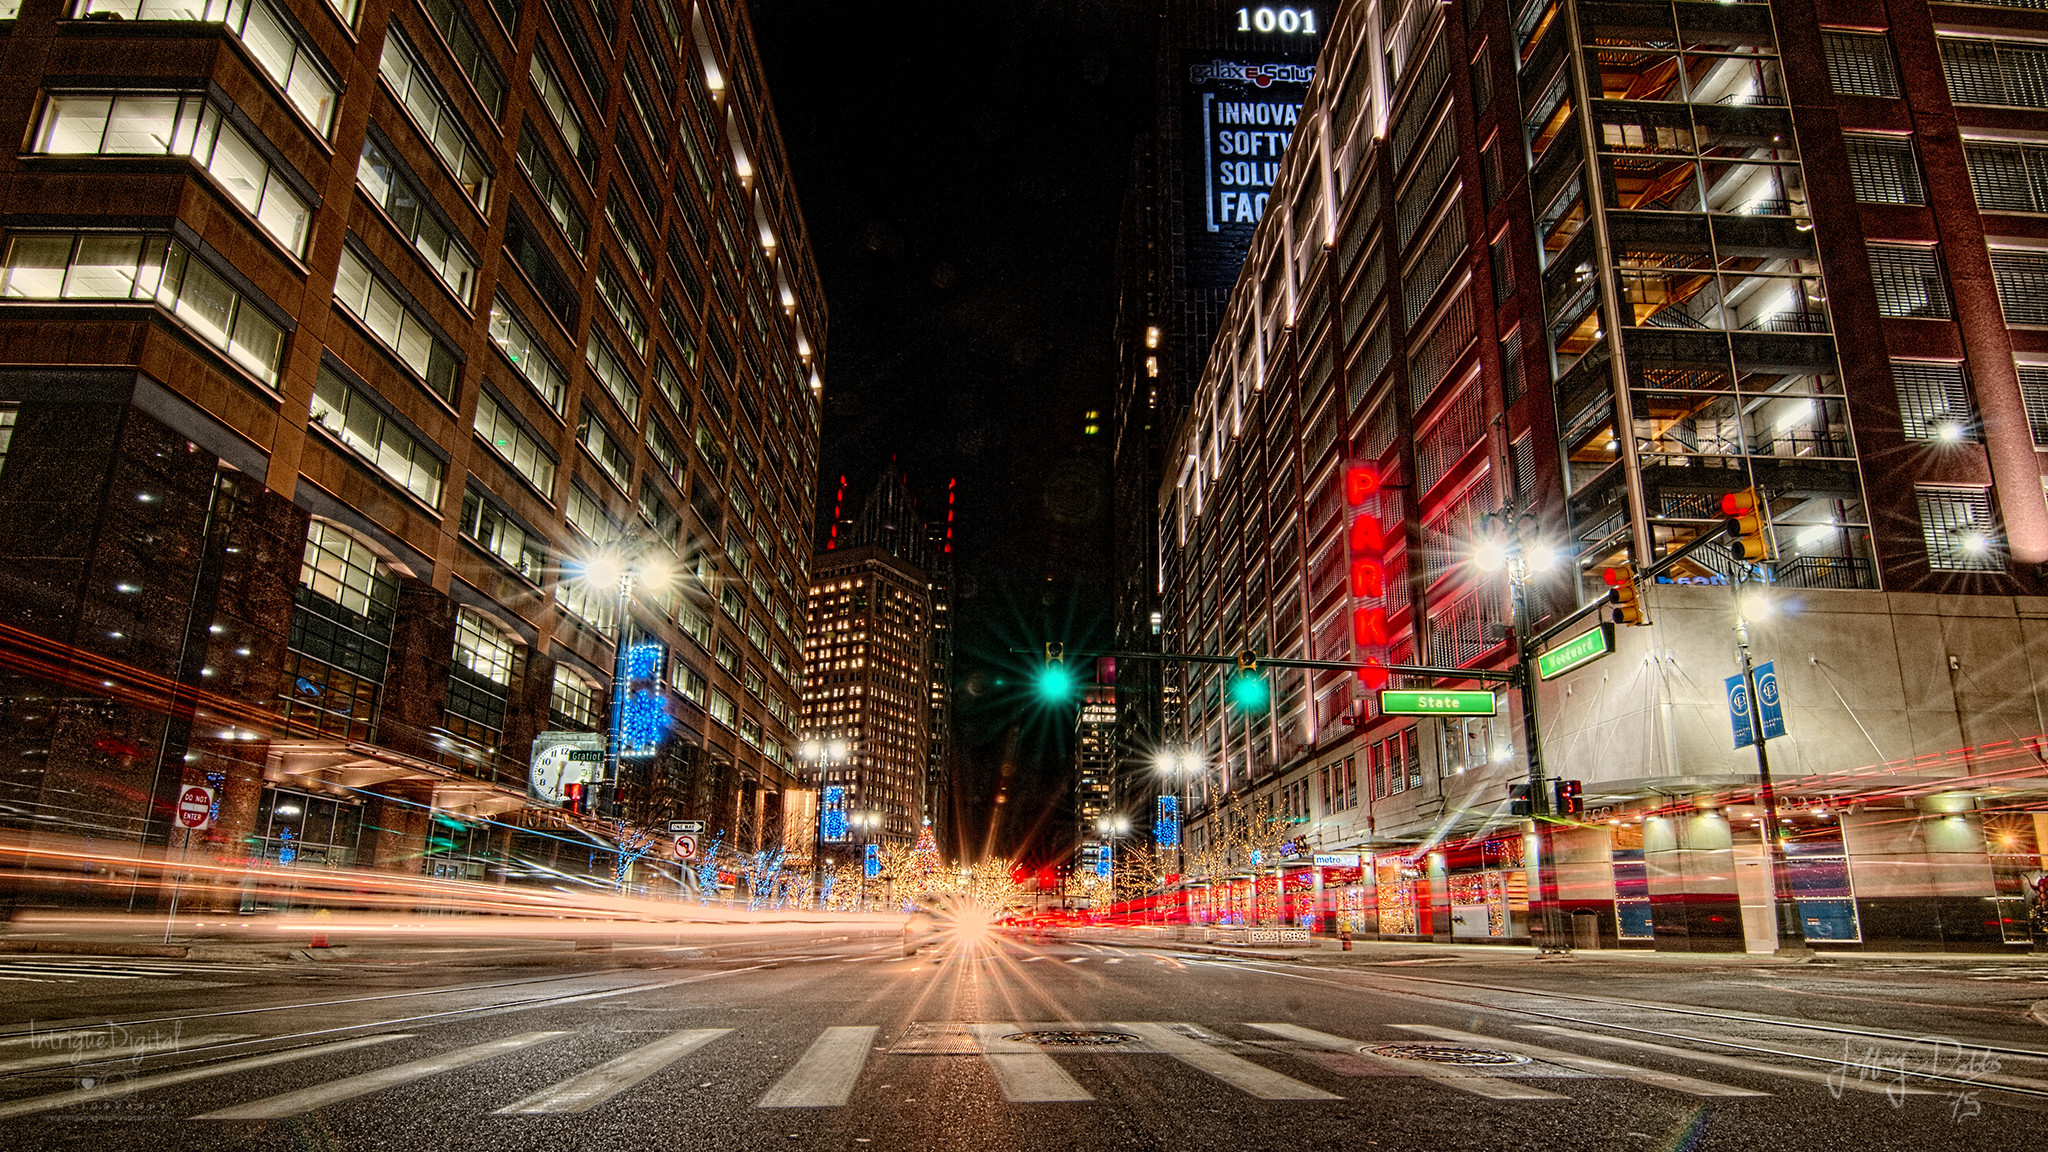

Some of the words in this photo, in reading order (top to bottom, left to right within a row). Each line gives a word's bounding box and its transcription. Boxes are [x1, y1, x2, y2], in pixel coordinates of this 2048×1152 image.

[1236, 8, 1317, 34] 1001
[1218, 102, 1304, 126] INNOVA
[1220, 161, 1282, 186] SOLU
[1346, 469, 1388, 646] PARK
[1547, 636, 1595, 669] Woodward
[1418, 697, 1460, 709] State
[572, 751, 601, 761] Gratiot
[541, 758, 552, 767] 10
[185, 793, 193, 801] DO
[183, 812, 202, 820] ENTER
[1316, 855, 1341, 864] metro
